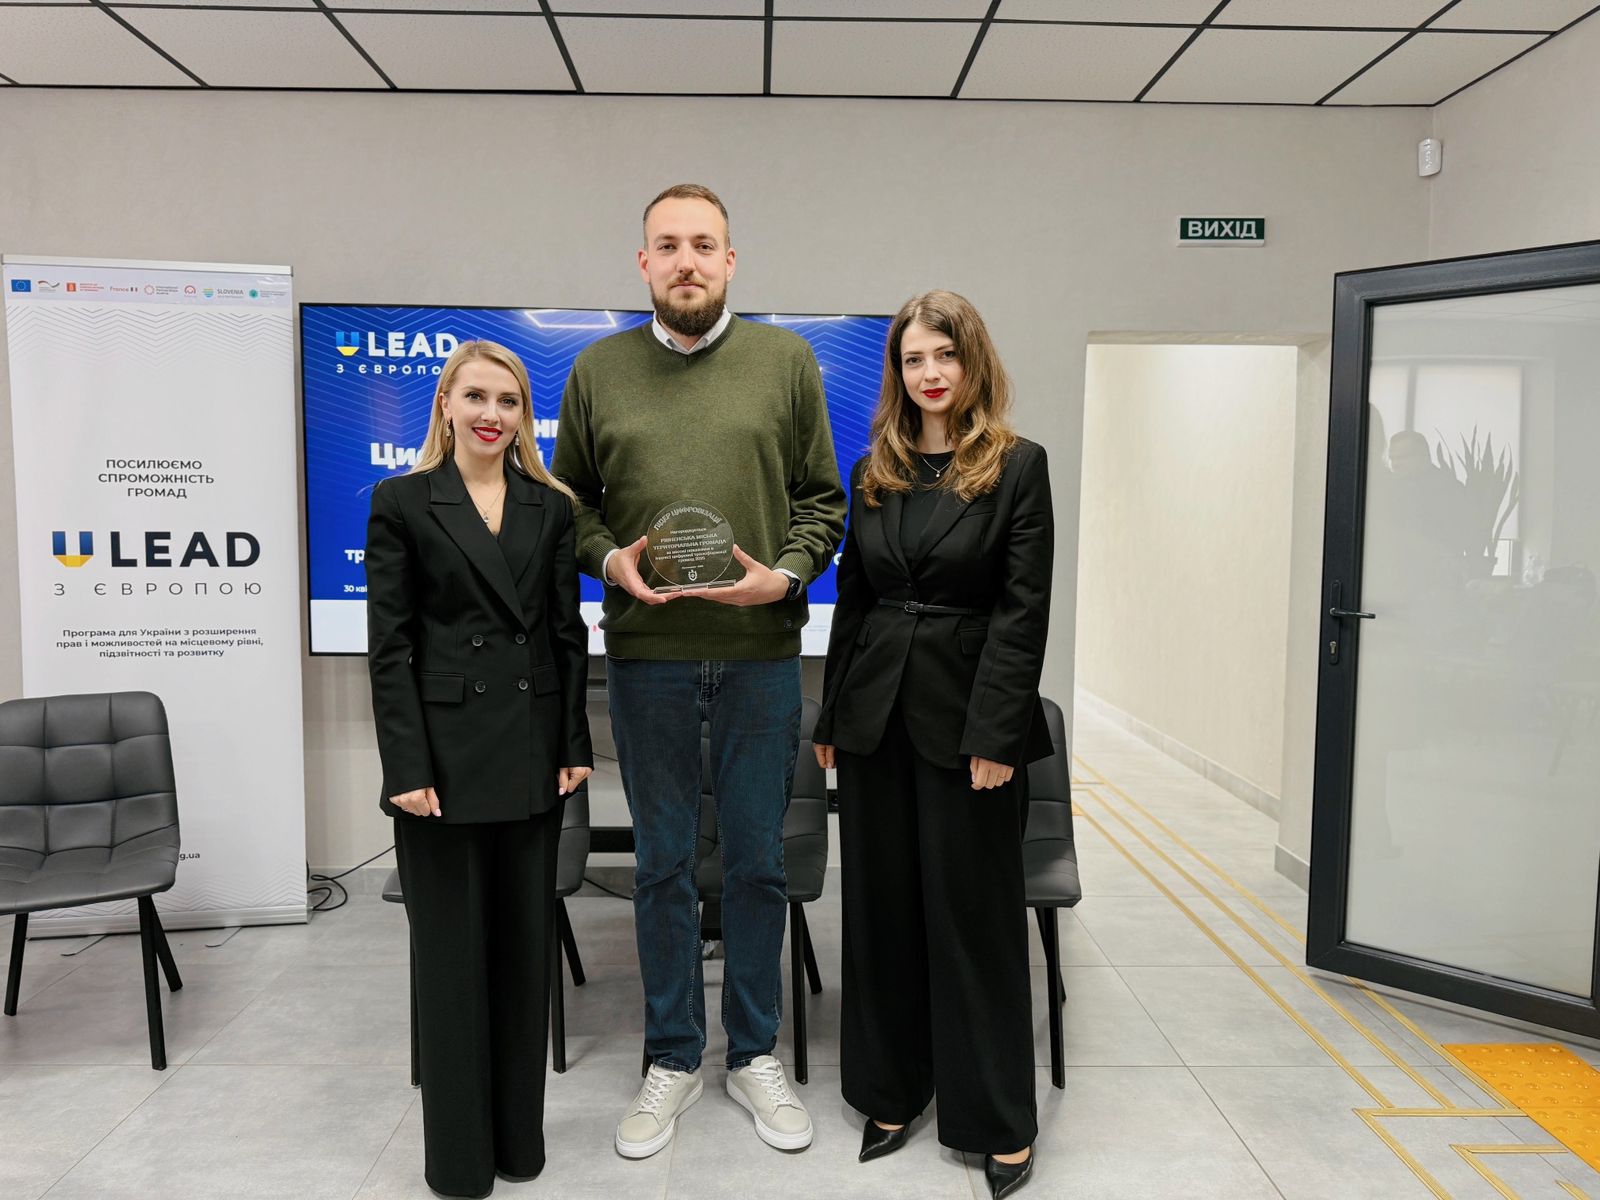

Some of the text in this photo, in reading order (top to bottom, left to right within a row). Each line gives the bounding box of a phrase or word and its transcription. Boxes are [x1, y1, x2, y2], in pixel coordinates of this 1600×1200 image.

[1188, 220, 1257, 239] ВИХІД
[368, 331, 459, 358] LEAD
[358, 364, 442, 375] ЄВРОПО
[370, 442, 421, 470] Ци
[106, 459, 202, 470] ПОСИЛЮЄМО
[98, 473, 215, 484] СПРОМОЖНІСТЬ
[127, 487, 187, 499] ГРОМАД
[110, 531, 261, 568] LEAD
[344, 549, 365, 564] тр
[53, 583, 262, 596] З ЄВРОПОЮ
[355, 585, 368, 593] кві
[62, 629, 116, 639] Програма
[118, 629, 138, 638] для
[140, 628, 181, 638] України
[192, 628, 257, 638] розширення
[56, 640, 82, 649] прав
[91, 638, 162, 647] можливостей
[180, 638, 235, 648] місцевому
[237, 637, 264, 647] рівні,
[99, 649, 161, 659] підзвітності
[177, 649, 225, 659] розвитку
[179, 852, 201, 861] g.ua
